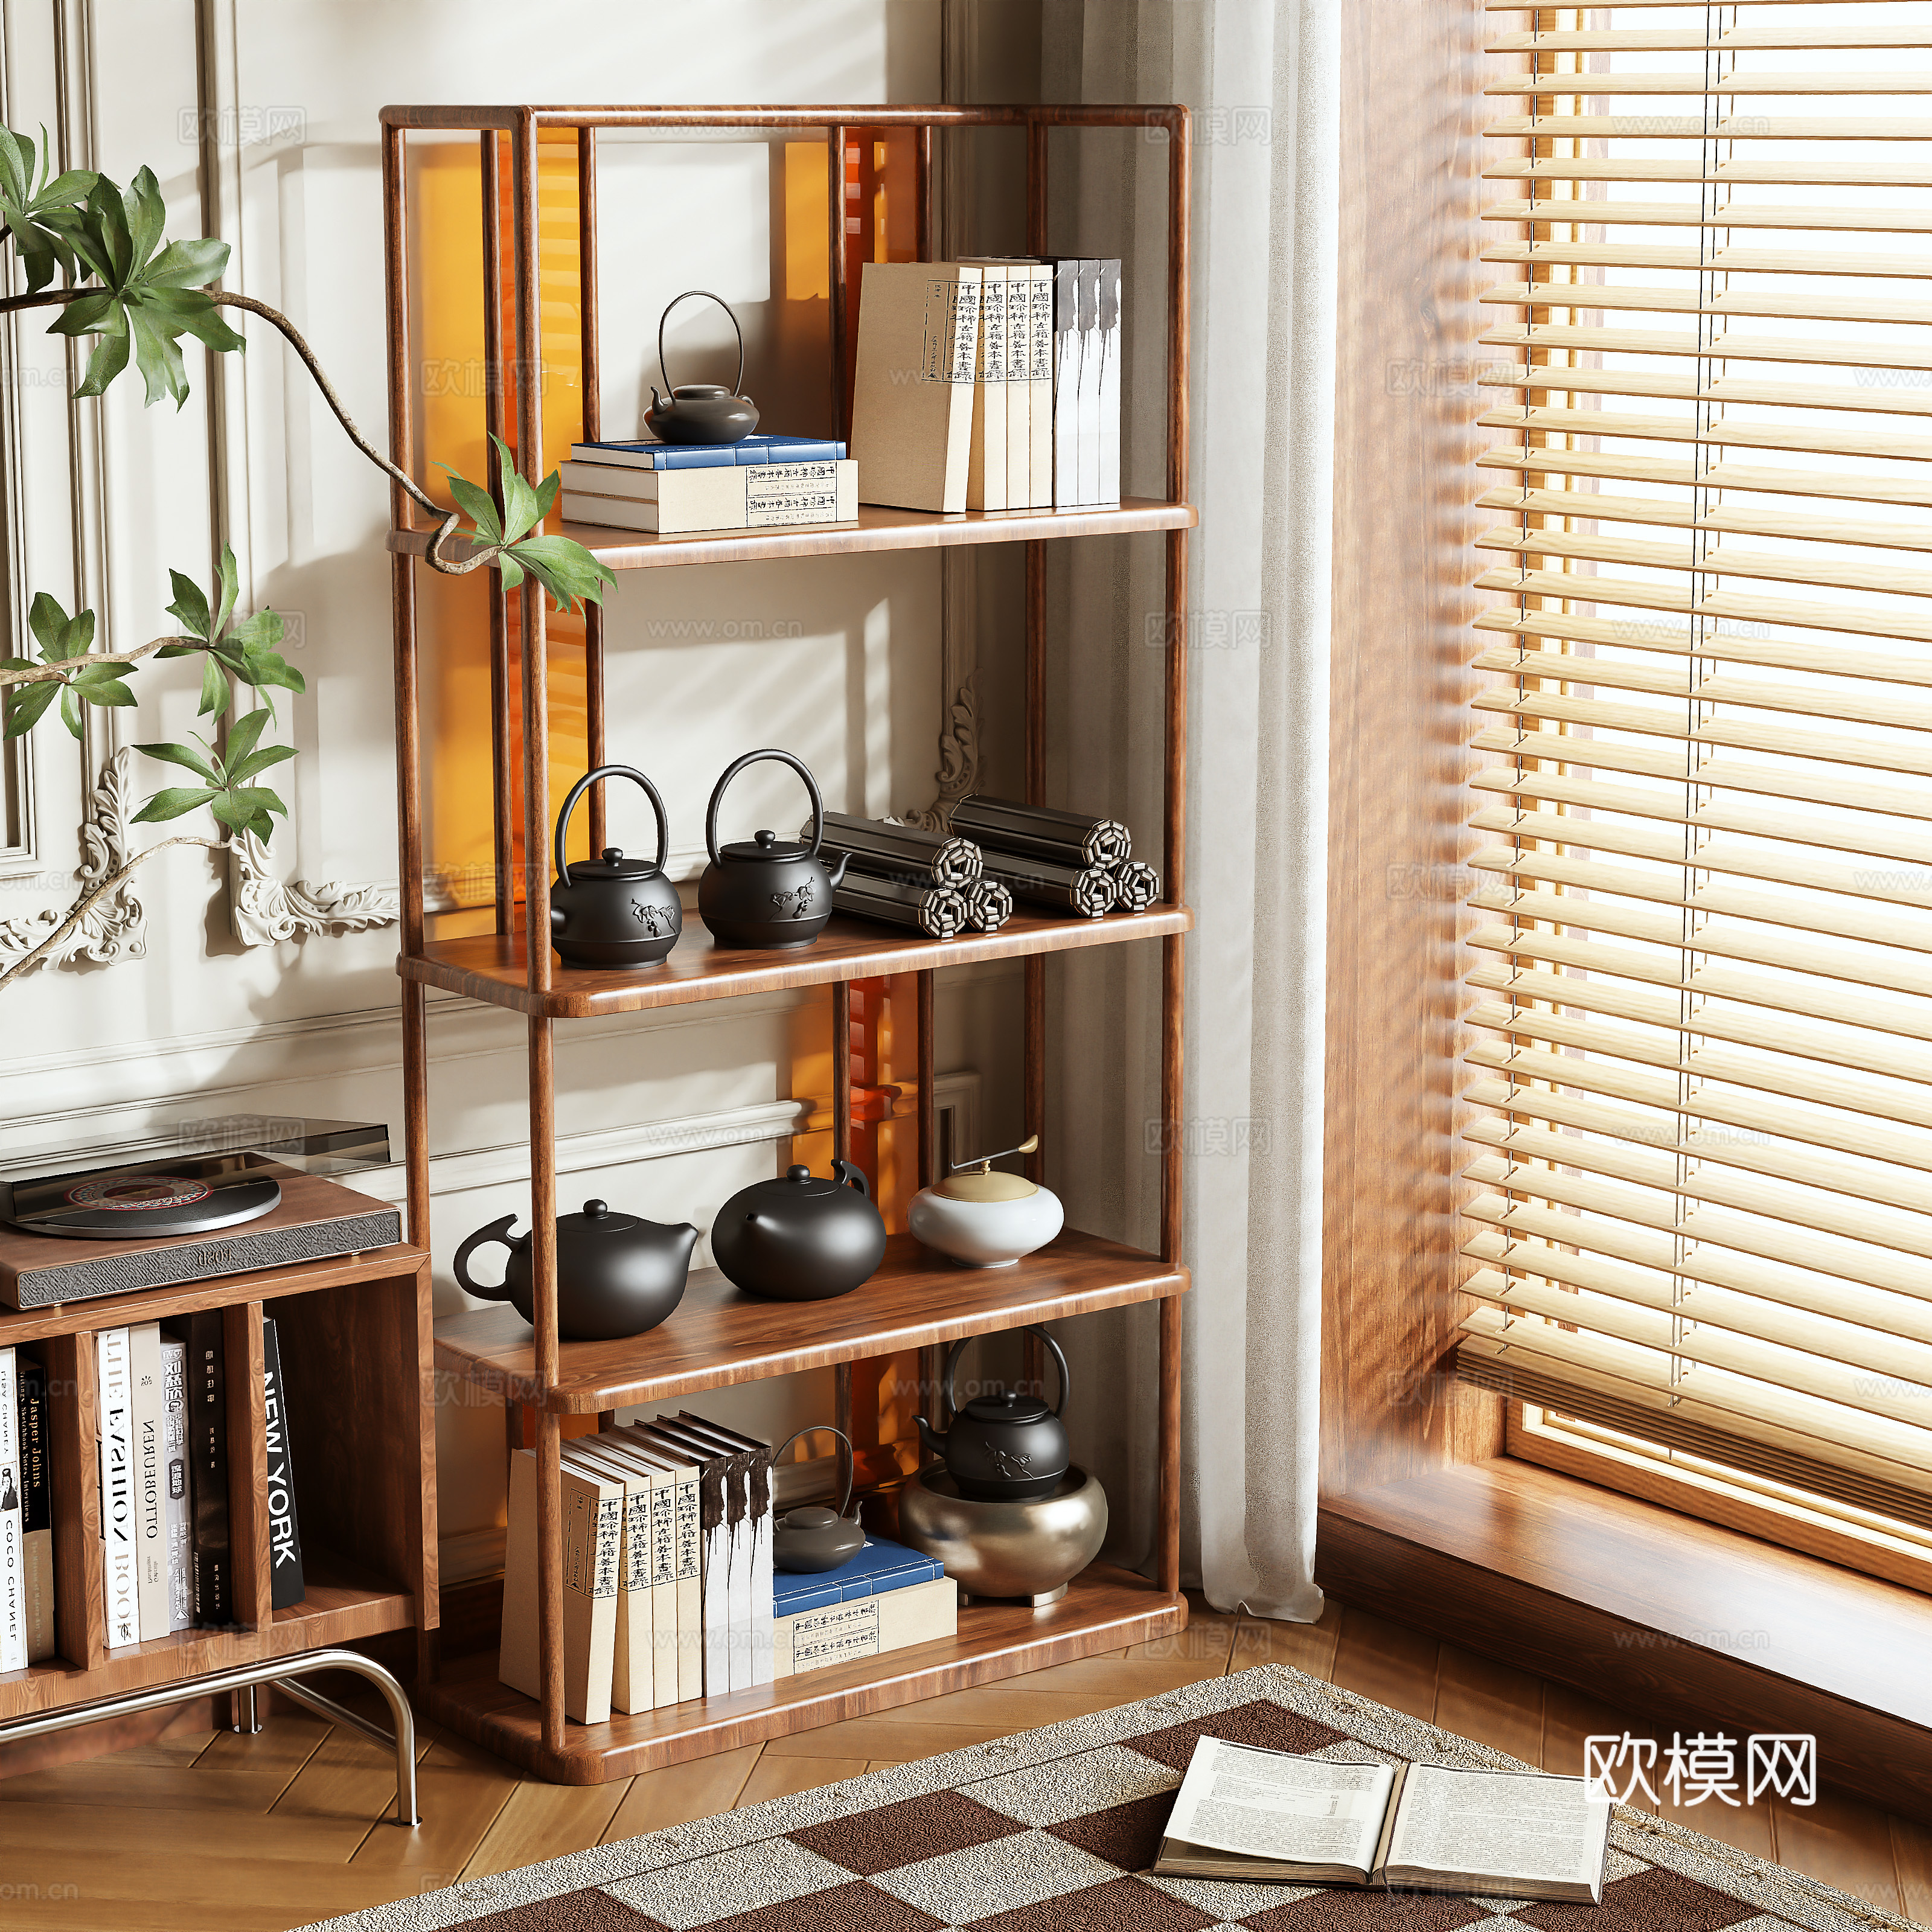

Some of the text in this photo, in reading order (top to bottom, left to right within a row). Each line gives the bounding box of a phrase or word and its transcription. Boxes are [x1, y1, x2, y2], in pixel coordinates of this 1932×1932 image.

[164, 1349, 182, 1360] My
[28, 1398, 42, 1488] Jasper Johns
[264, 1371, 296, 1569] NEW YORK
